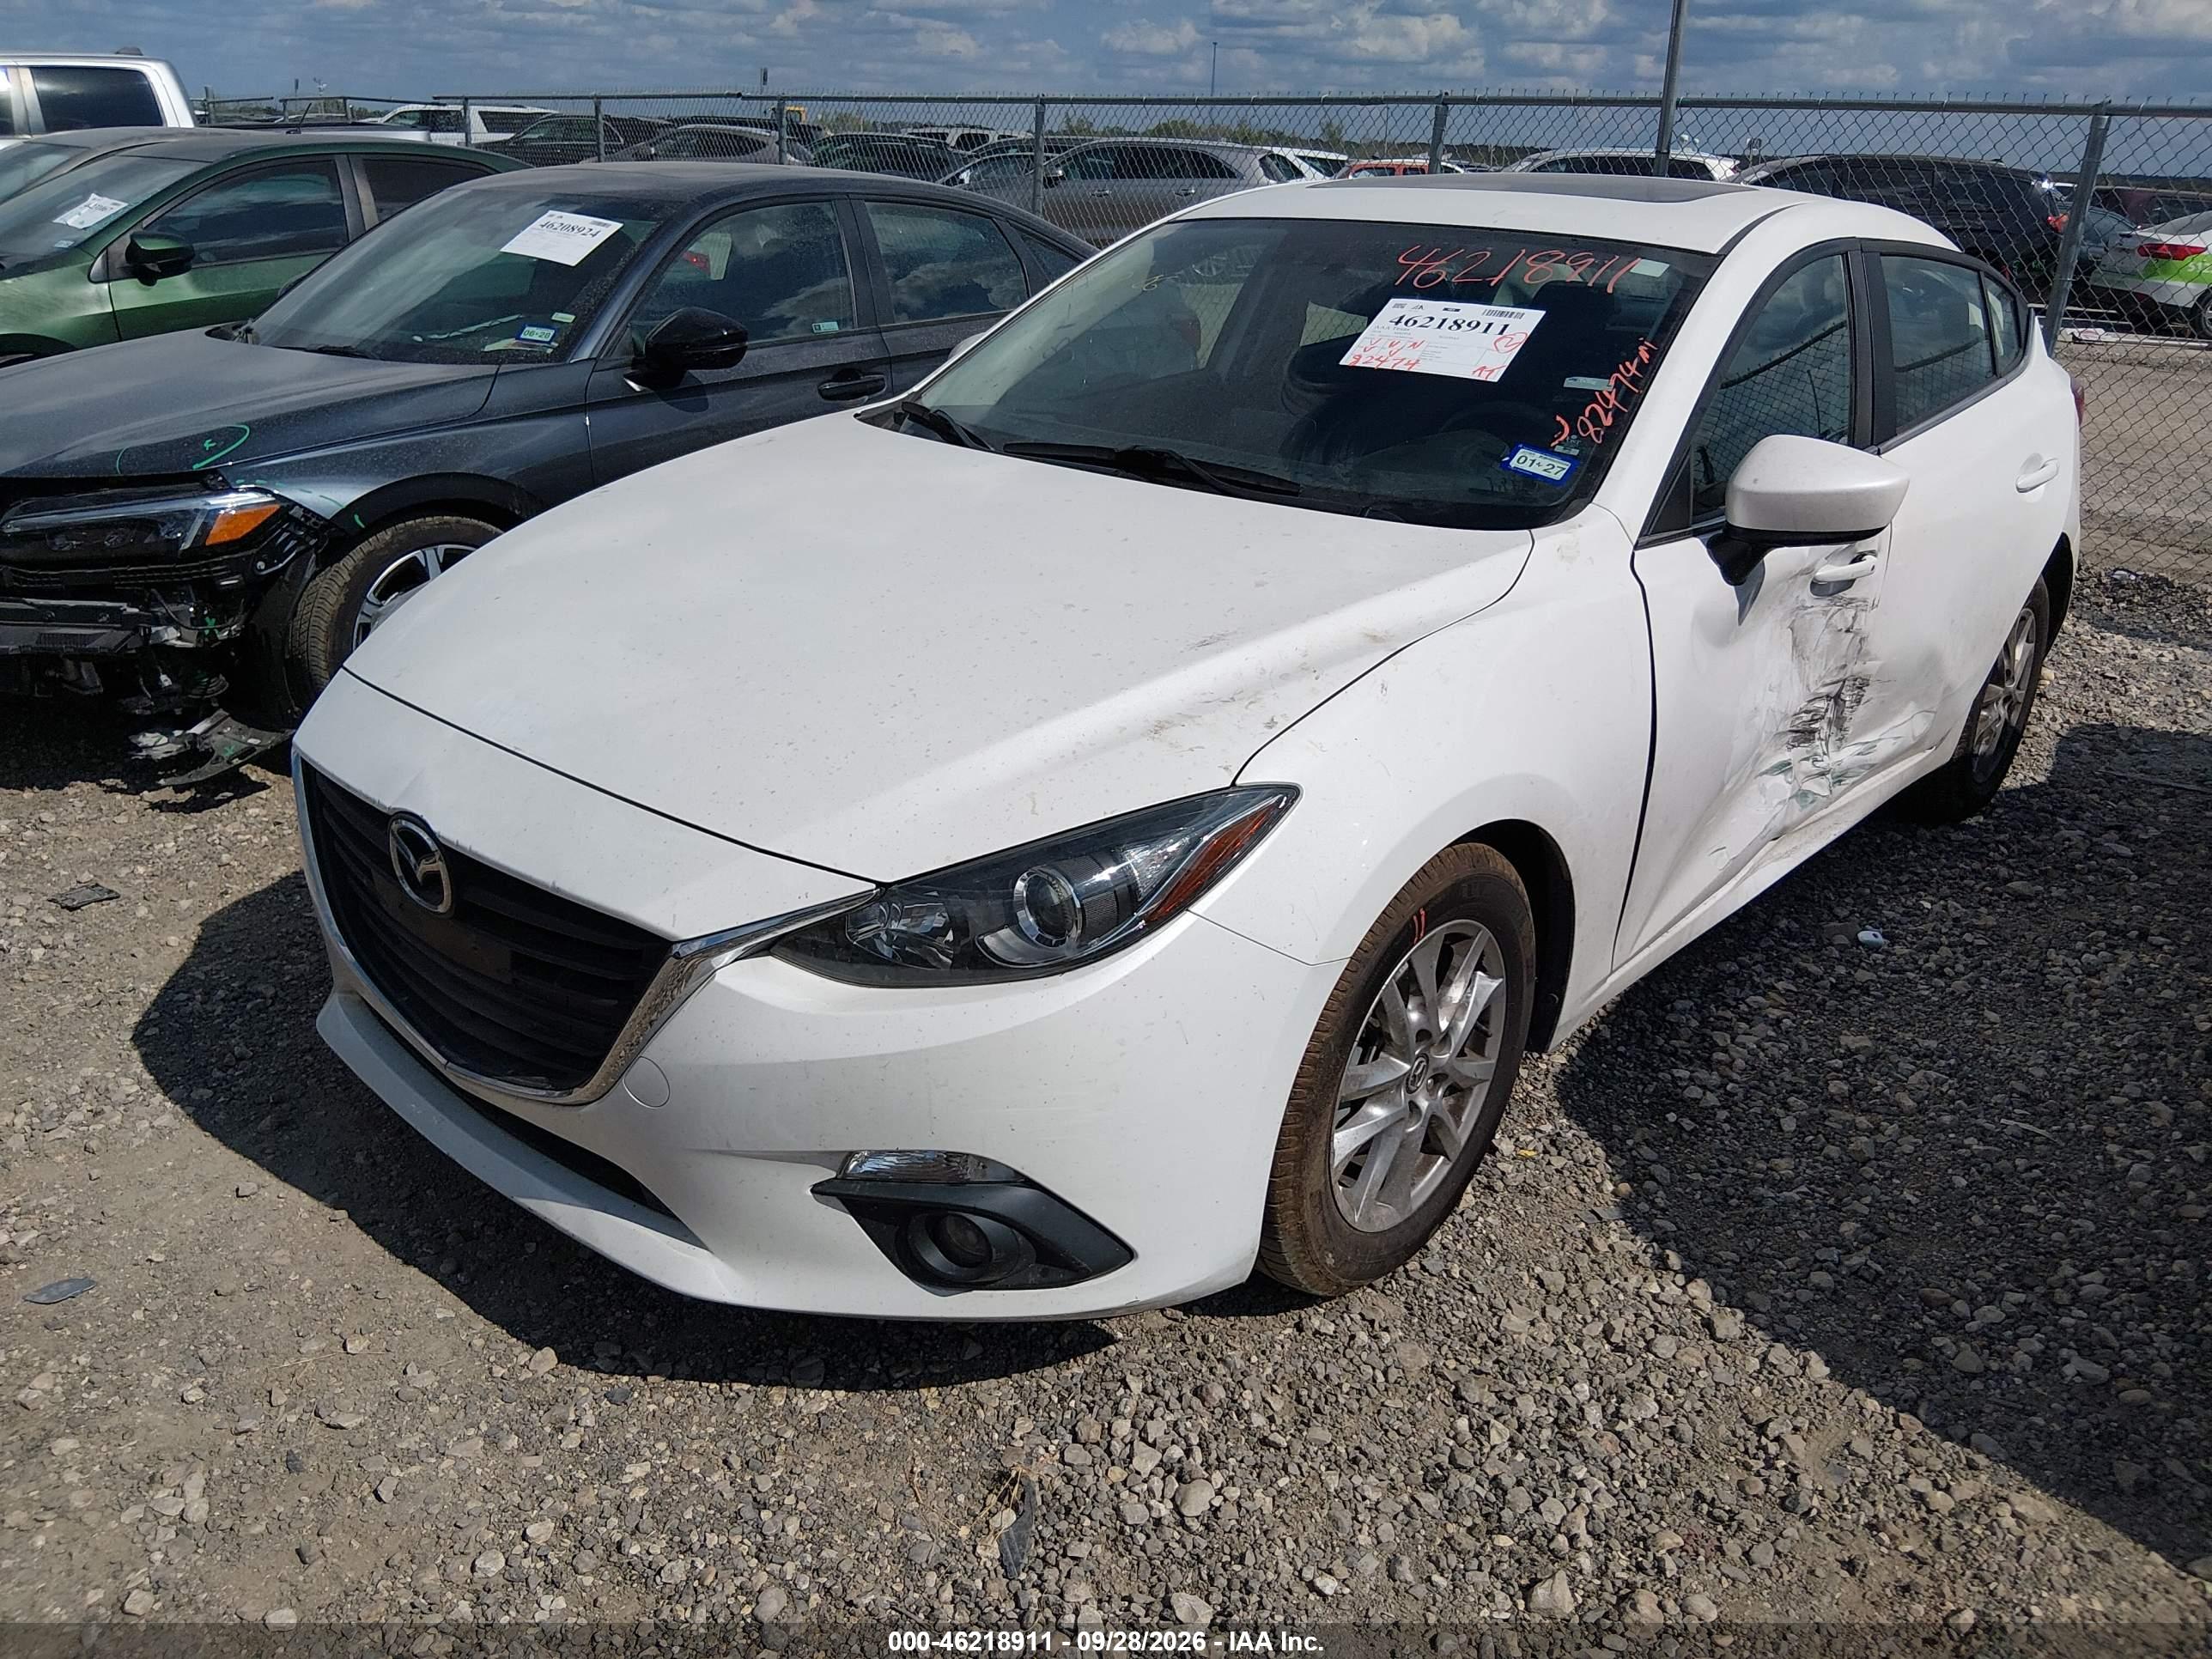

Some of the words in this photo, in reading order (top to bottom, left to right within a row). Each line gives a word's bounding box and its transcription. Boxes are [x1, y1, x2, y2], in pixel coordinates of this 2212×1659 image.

[538, 221, 601, 238] 46208924
[1395, 245, 1642, 294] 46218911
[1389, 314, 1510, 336] 46218911
[1349, 355, 1420, 371] 82474
